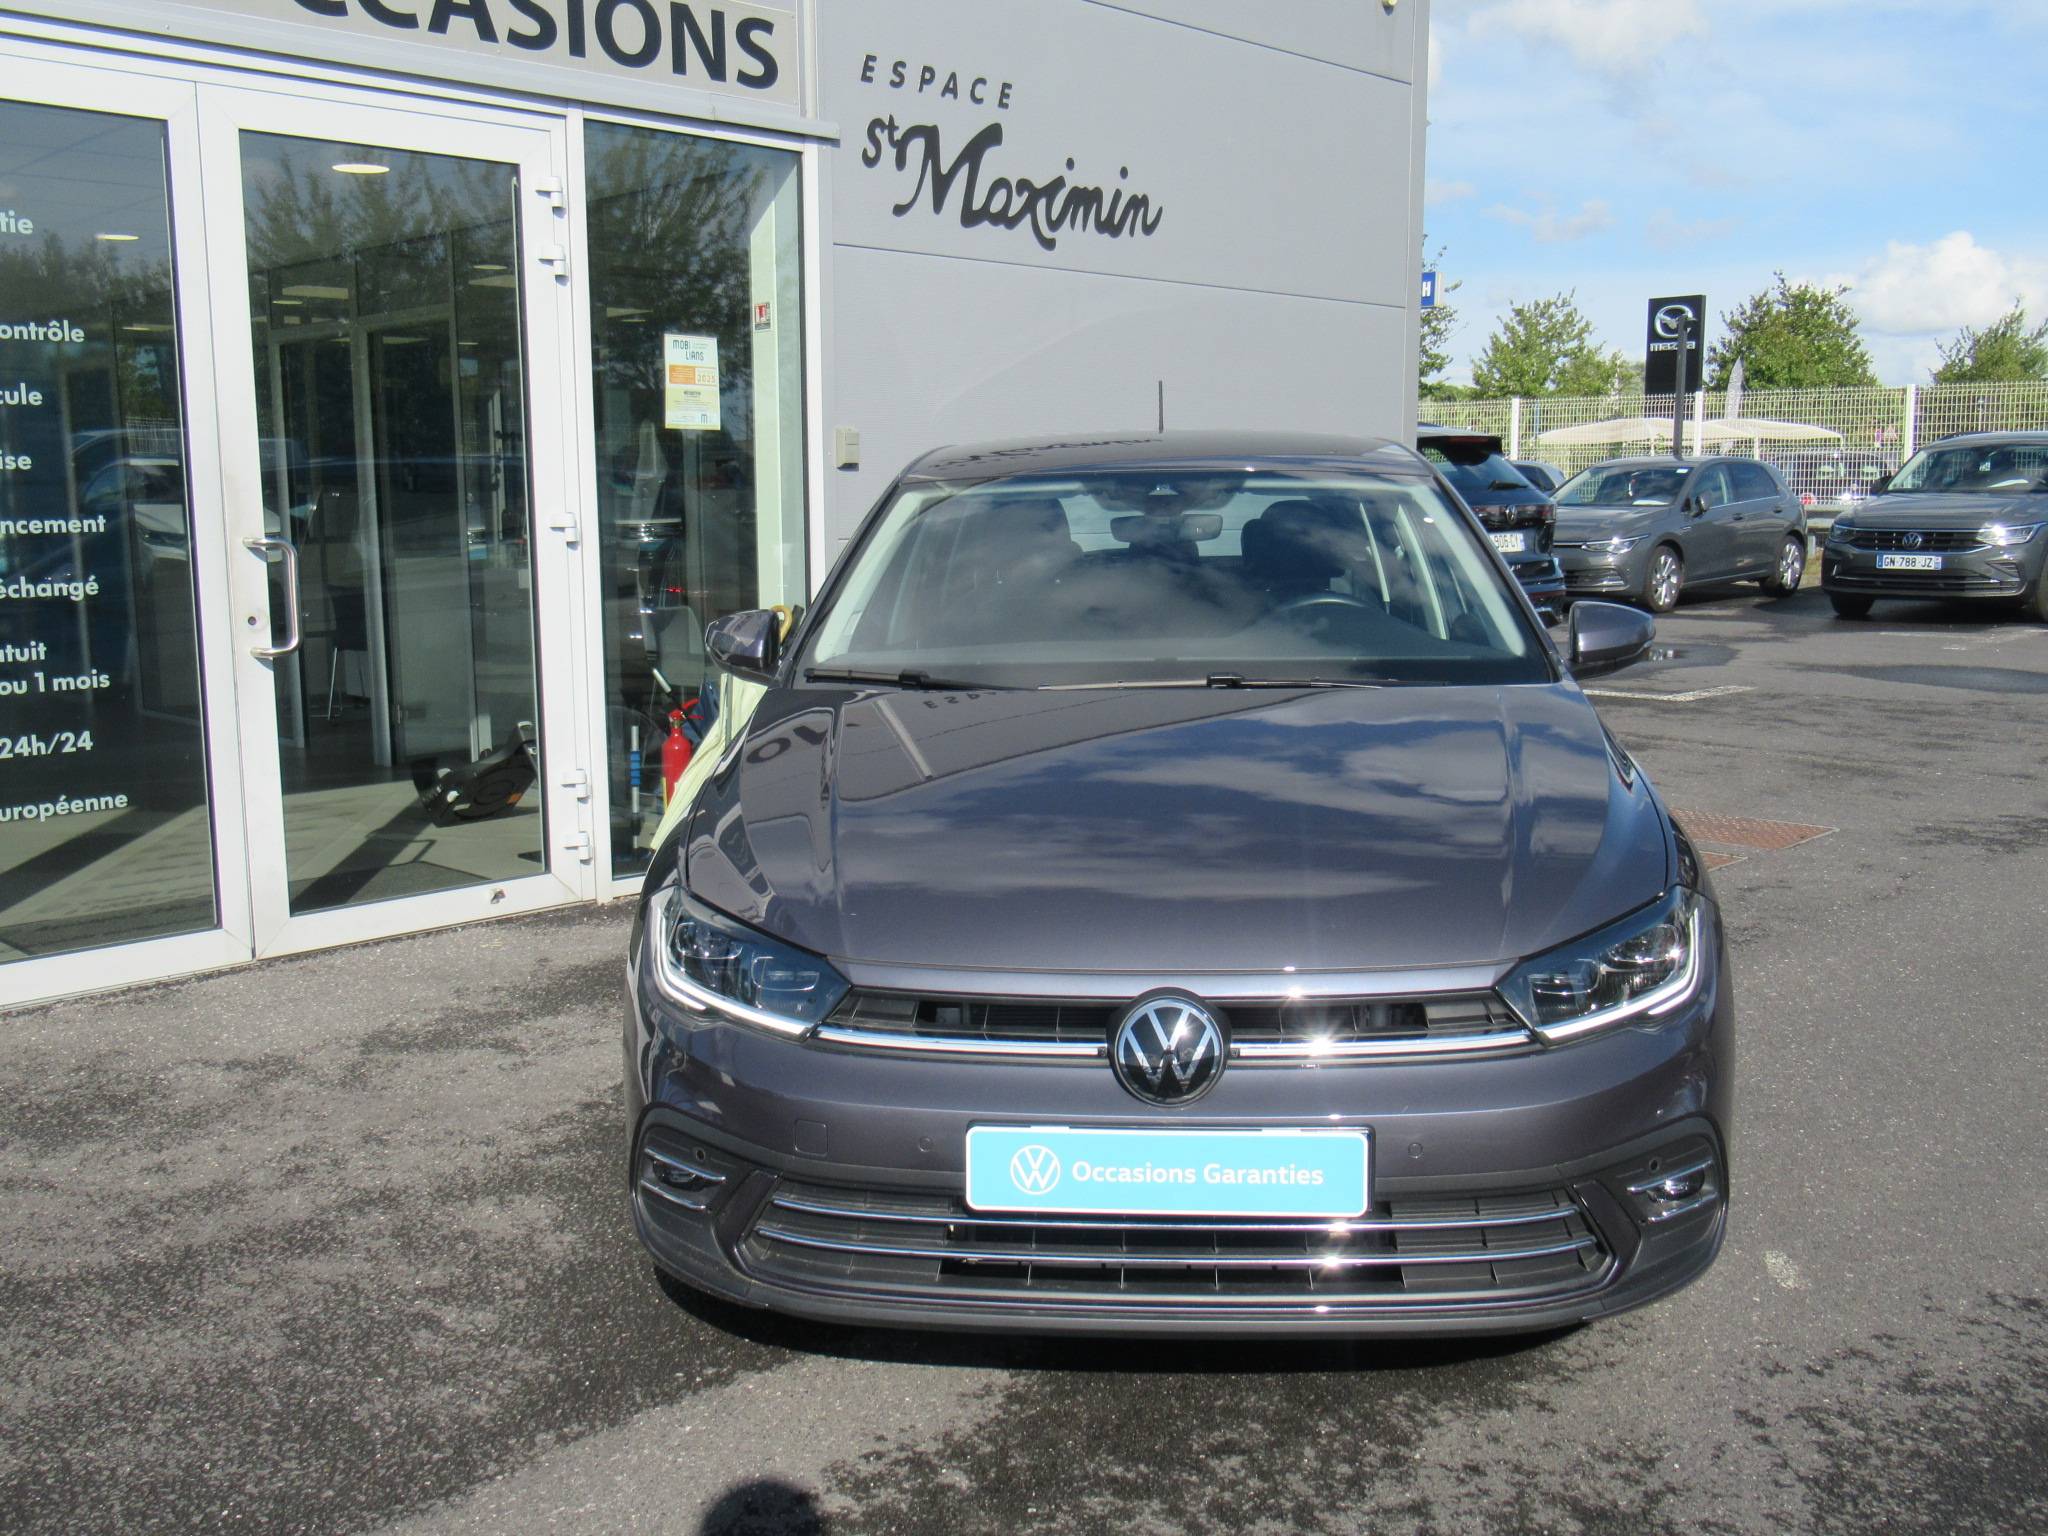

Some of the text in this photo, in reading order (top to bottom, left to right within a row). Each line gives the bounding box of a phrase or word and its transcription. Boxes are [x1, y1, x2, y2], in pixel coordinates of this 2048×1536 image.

[860, 54, 1013, 110] ESPACE
[892, 122, 1163, 251] Maximin
[1649, 341, 1696, 352] maza
[0, 669, 110, 695] ou 1 mois
[0, 730, 94, 759] 24h/24
[1072, 1160, 1196, 1184] Occasions
[1203, 1163, 1324, 1186] Garanties
